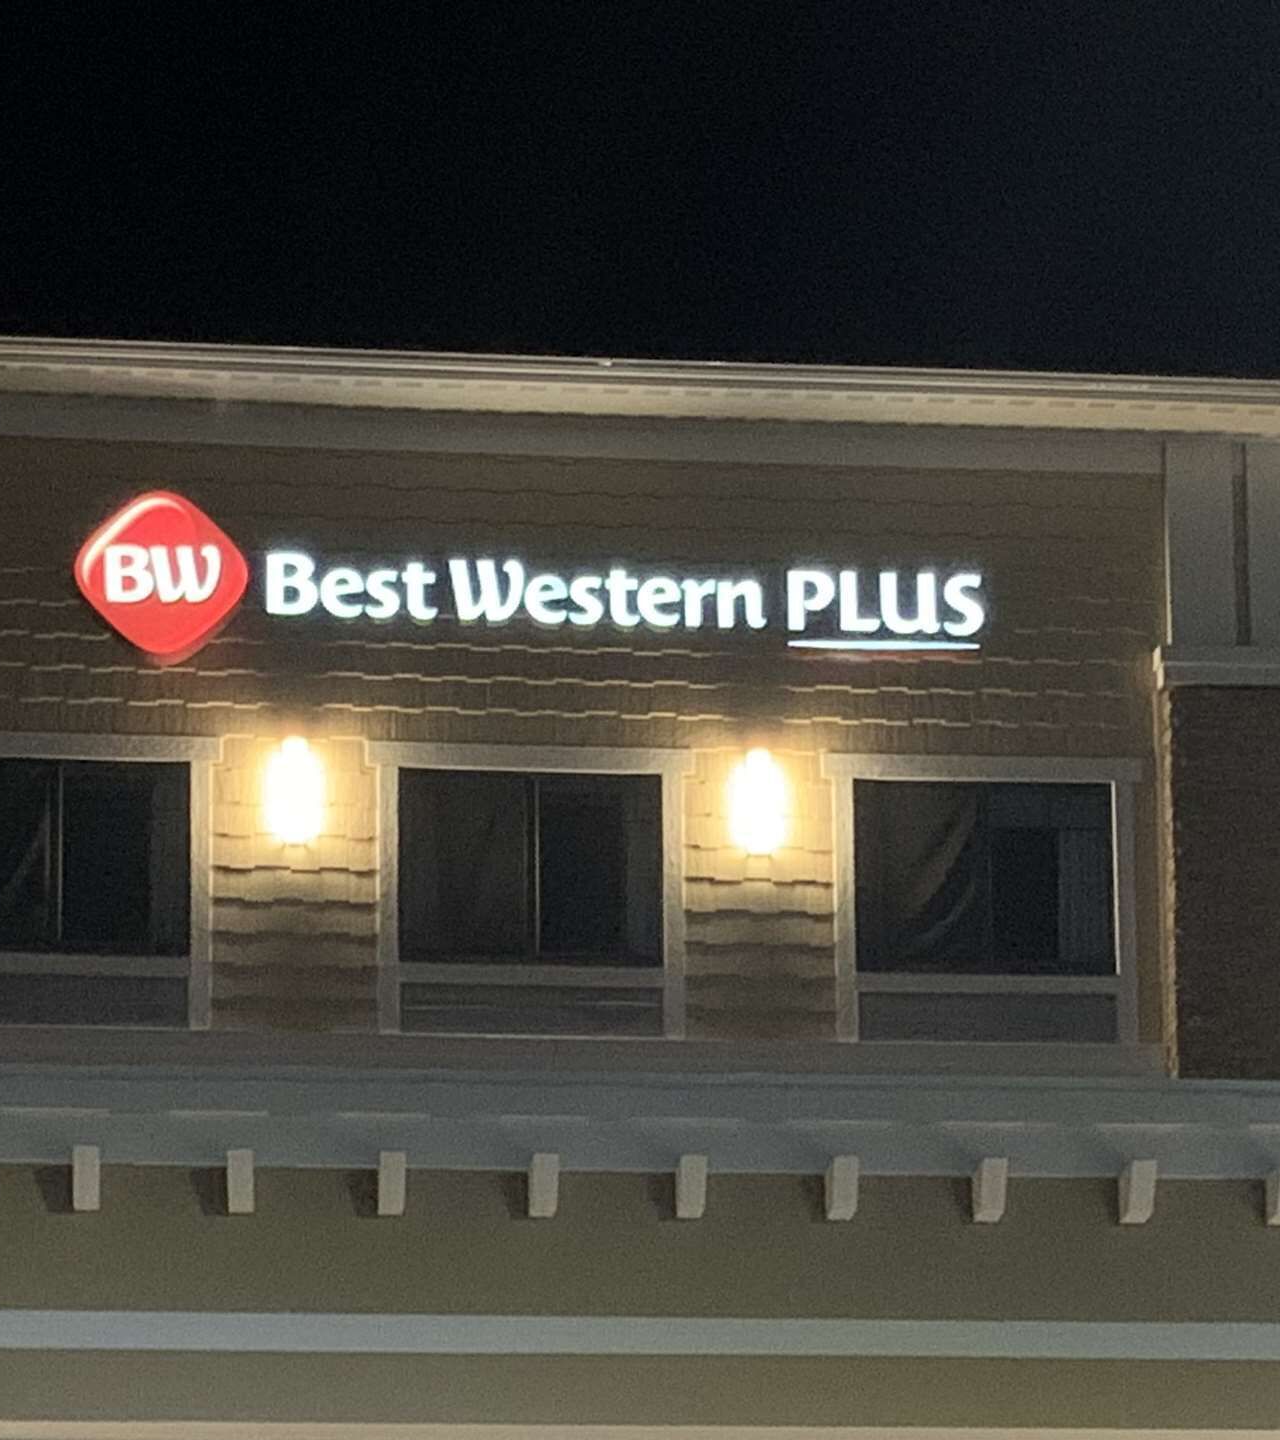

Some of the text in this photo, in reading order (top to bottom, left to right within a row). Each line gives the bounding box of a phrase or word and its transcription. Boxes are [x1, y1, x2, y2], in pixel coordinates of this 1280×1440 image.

[104, 543, 221, 604] BW
[265, 551, 986, 636] Best Western PLUS
